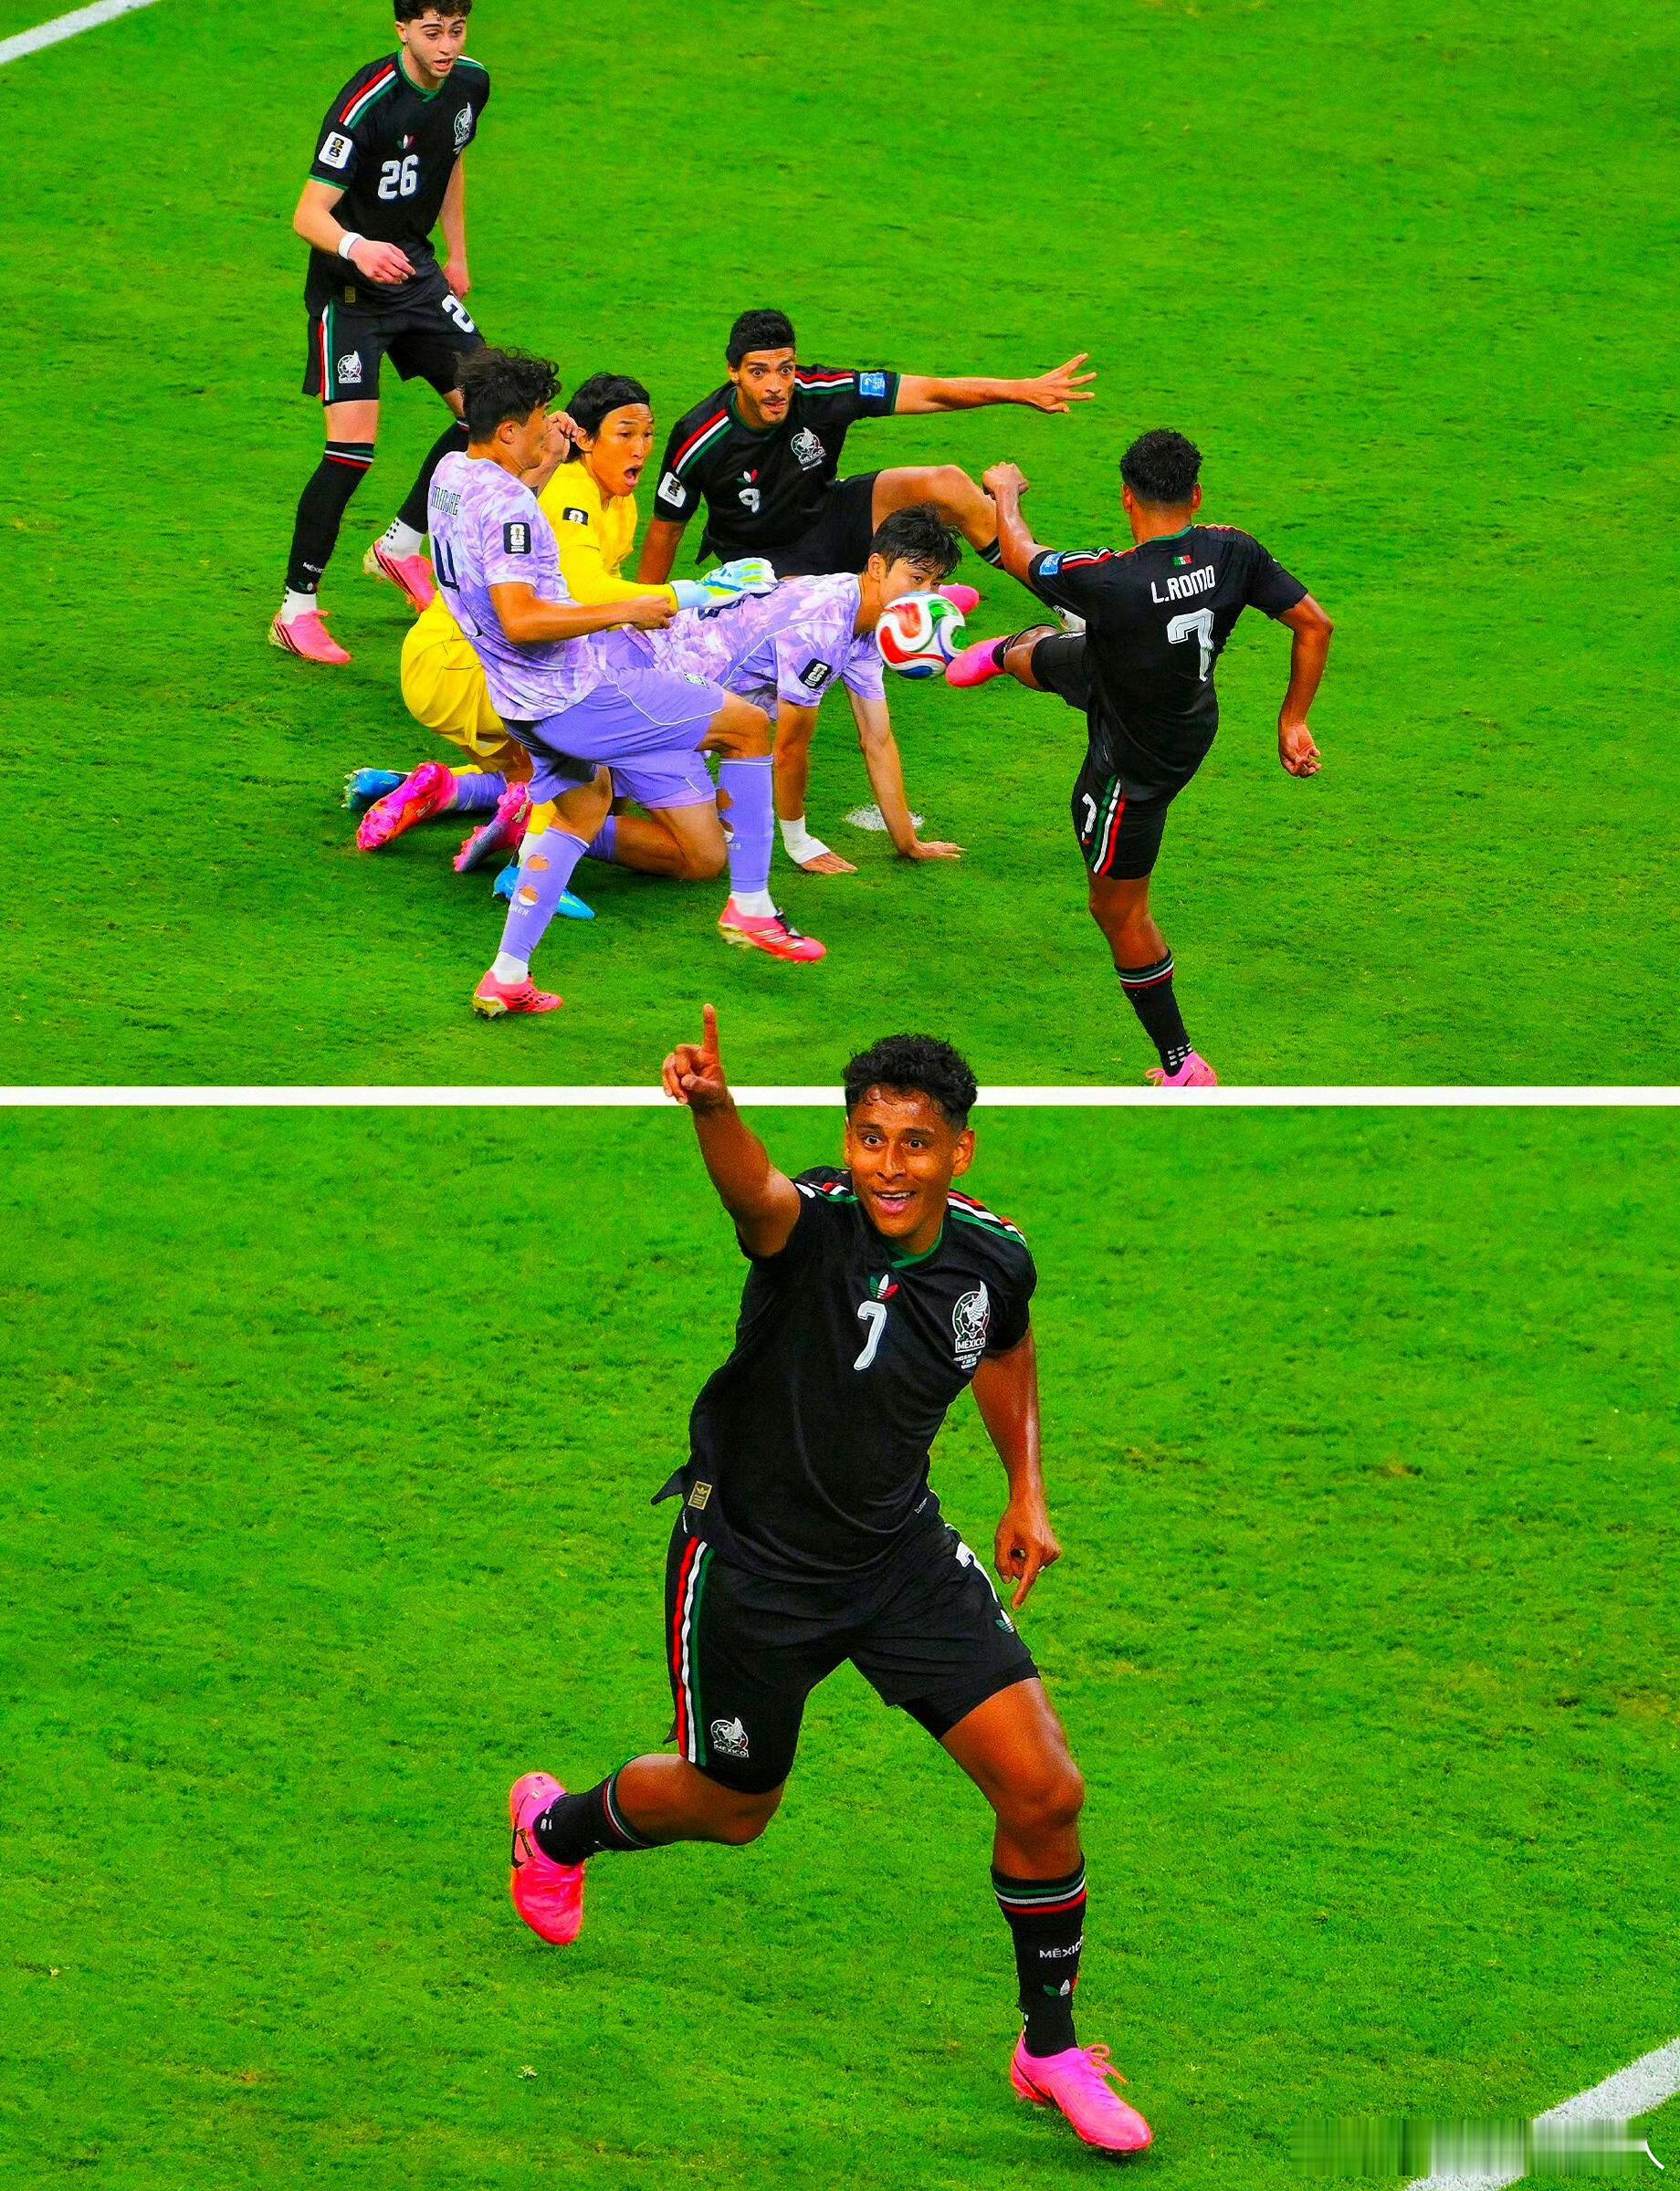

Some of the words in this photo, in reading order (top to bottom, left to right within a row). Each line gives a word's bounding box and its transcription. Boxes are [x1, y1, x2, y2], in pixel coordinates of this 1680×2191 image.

[378, 154, 419, 199] 26
[442, 291, 475, 332] 2
[739, 488, 760, 513] 9
[1150, 565, 1216, 603] L.ROMO
[1167, 607, 1214, 682] 7
[854, 1300, 887, 1370] 7
[957, 1337, 985, 1350] MÉXICO
